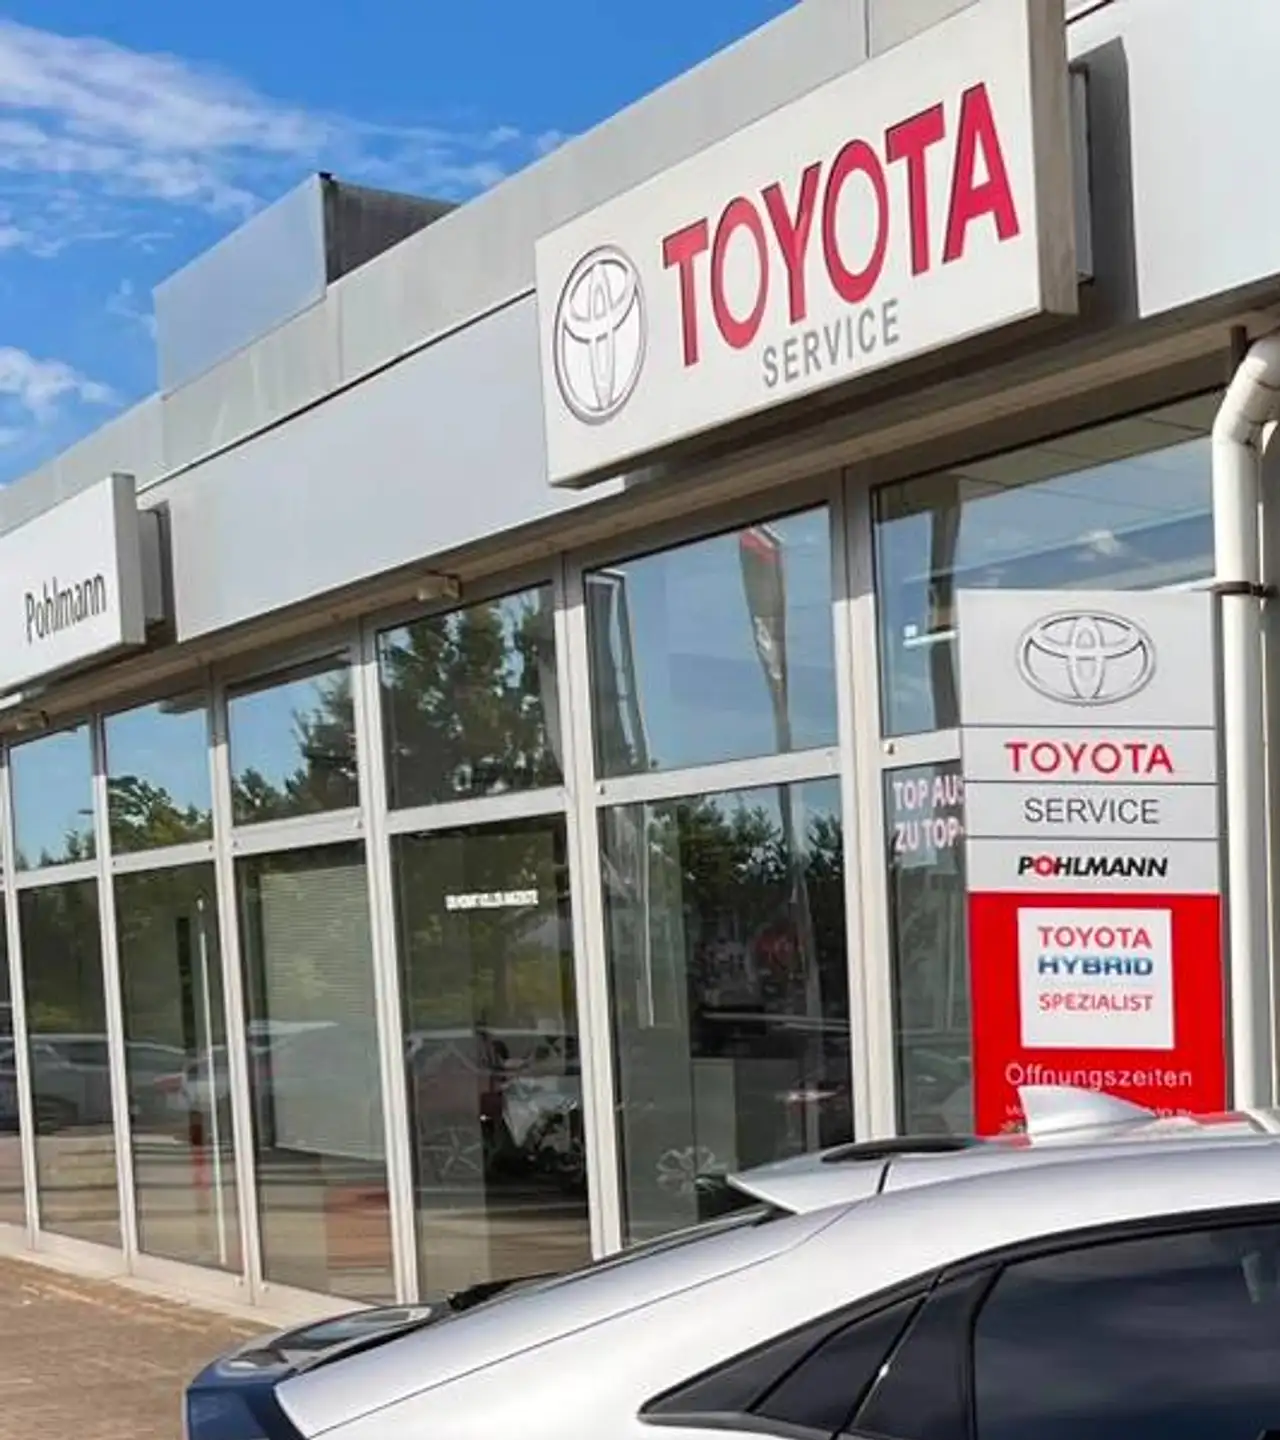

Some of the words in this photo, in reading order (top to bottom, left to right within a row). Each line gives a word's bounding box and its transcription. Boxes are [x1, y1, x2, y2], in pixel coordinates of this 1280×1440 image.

[662, 81, 1021, 367] TOYOTA
[761, 298, 901, 389] SERVICE
[24, 572, 107, 645] Pohlmann
[1005, 742, 1175, 774] TOYOTA
[892, 776, 929, 811] TOP
[1024, 798, 1161, 825] SERVICE
[894, 819, 919, 853] ZU
[1017, 855, 1169, 878] POHLMANN
[1037, 925, 1153, 949] TOYOTA
[1037, 955, 1153, 976] HYBRID
[1038, 993, 1153, 1012] SPEZIALIST
